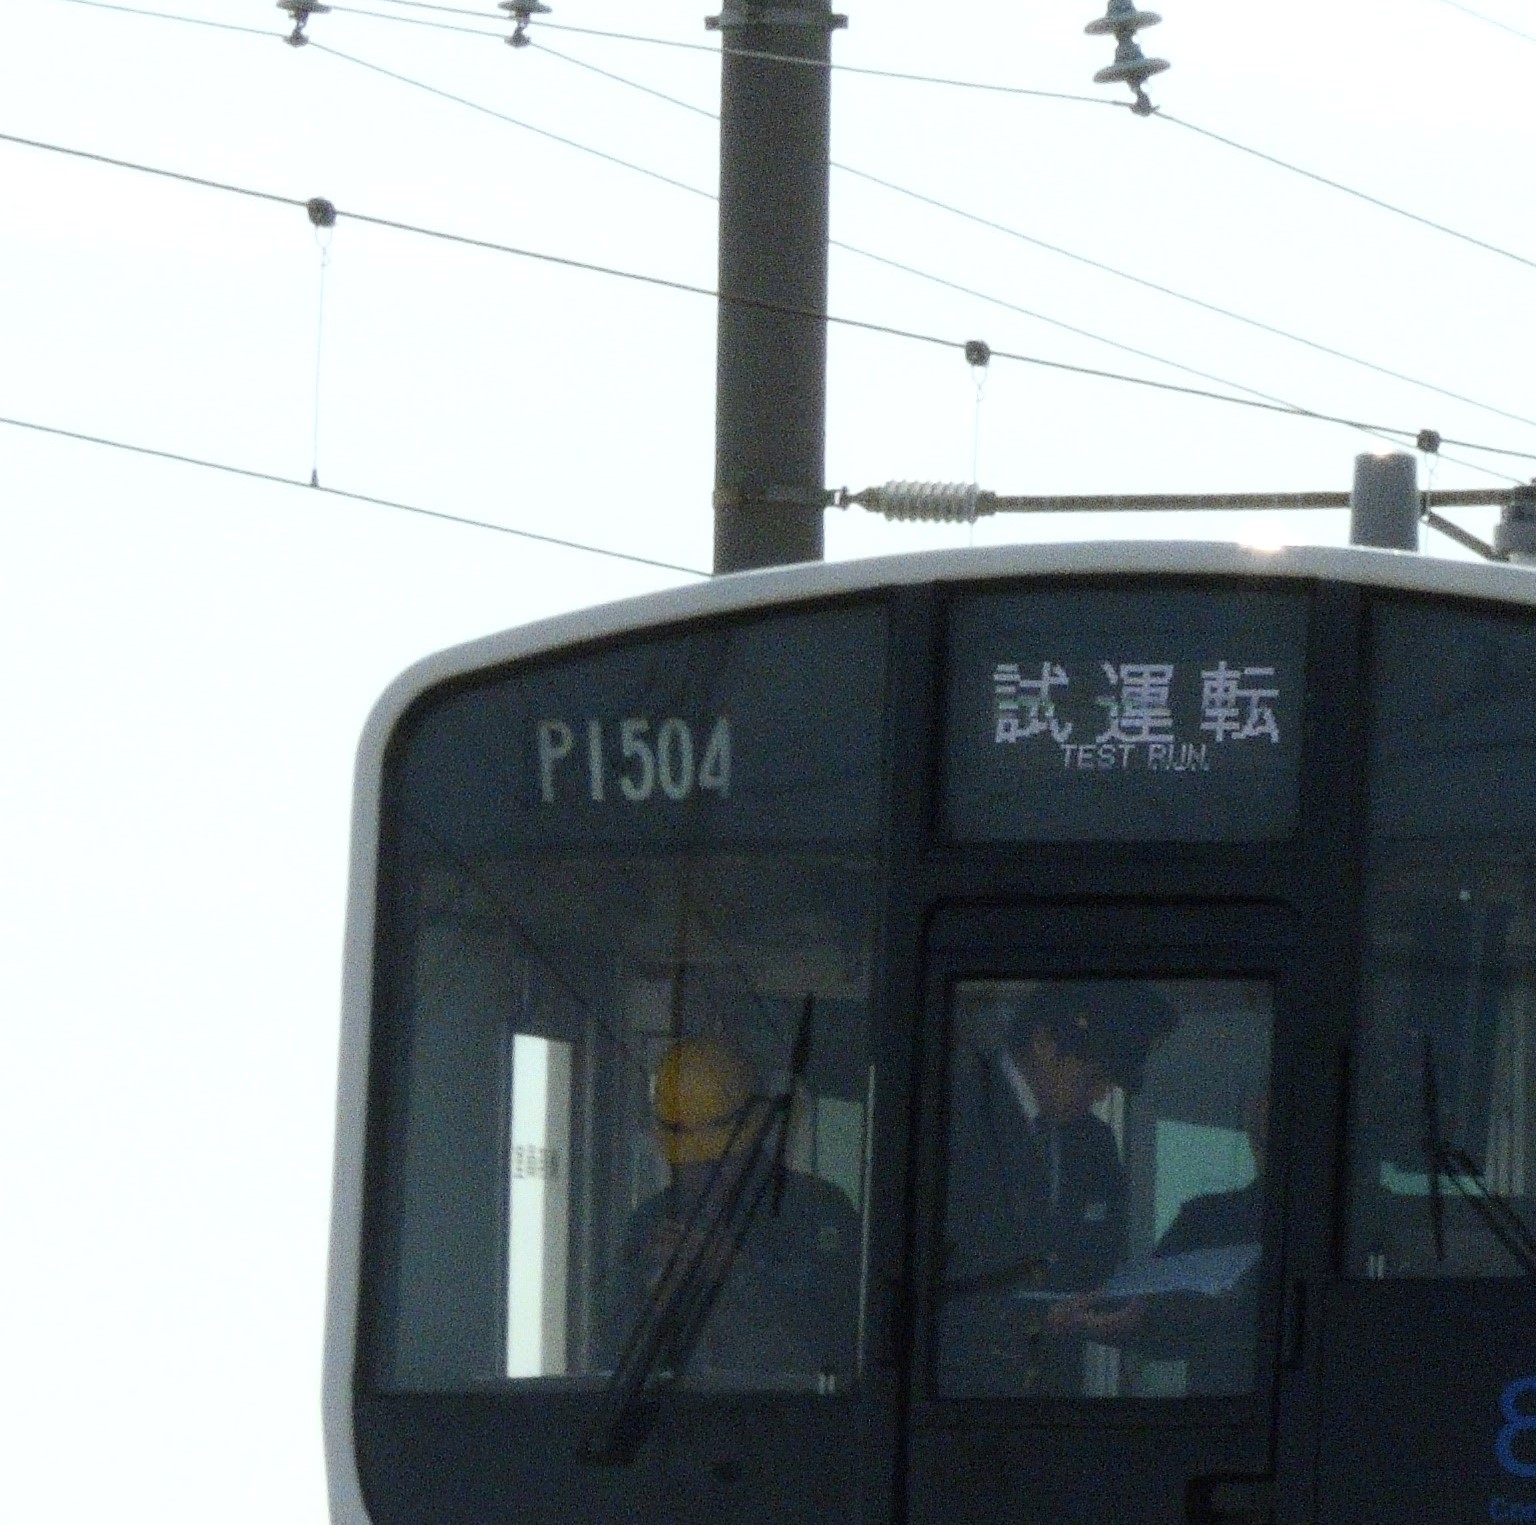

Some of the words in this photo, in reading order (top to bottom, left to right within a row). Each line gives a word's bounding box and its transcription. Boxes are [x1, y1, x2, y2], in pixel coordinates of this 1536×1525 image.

[992, 660, 1282, 744] 試運転
[1061, 743, 1137, 769] TEST
[1149, 743, 1210, 772] RUN
